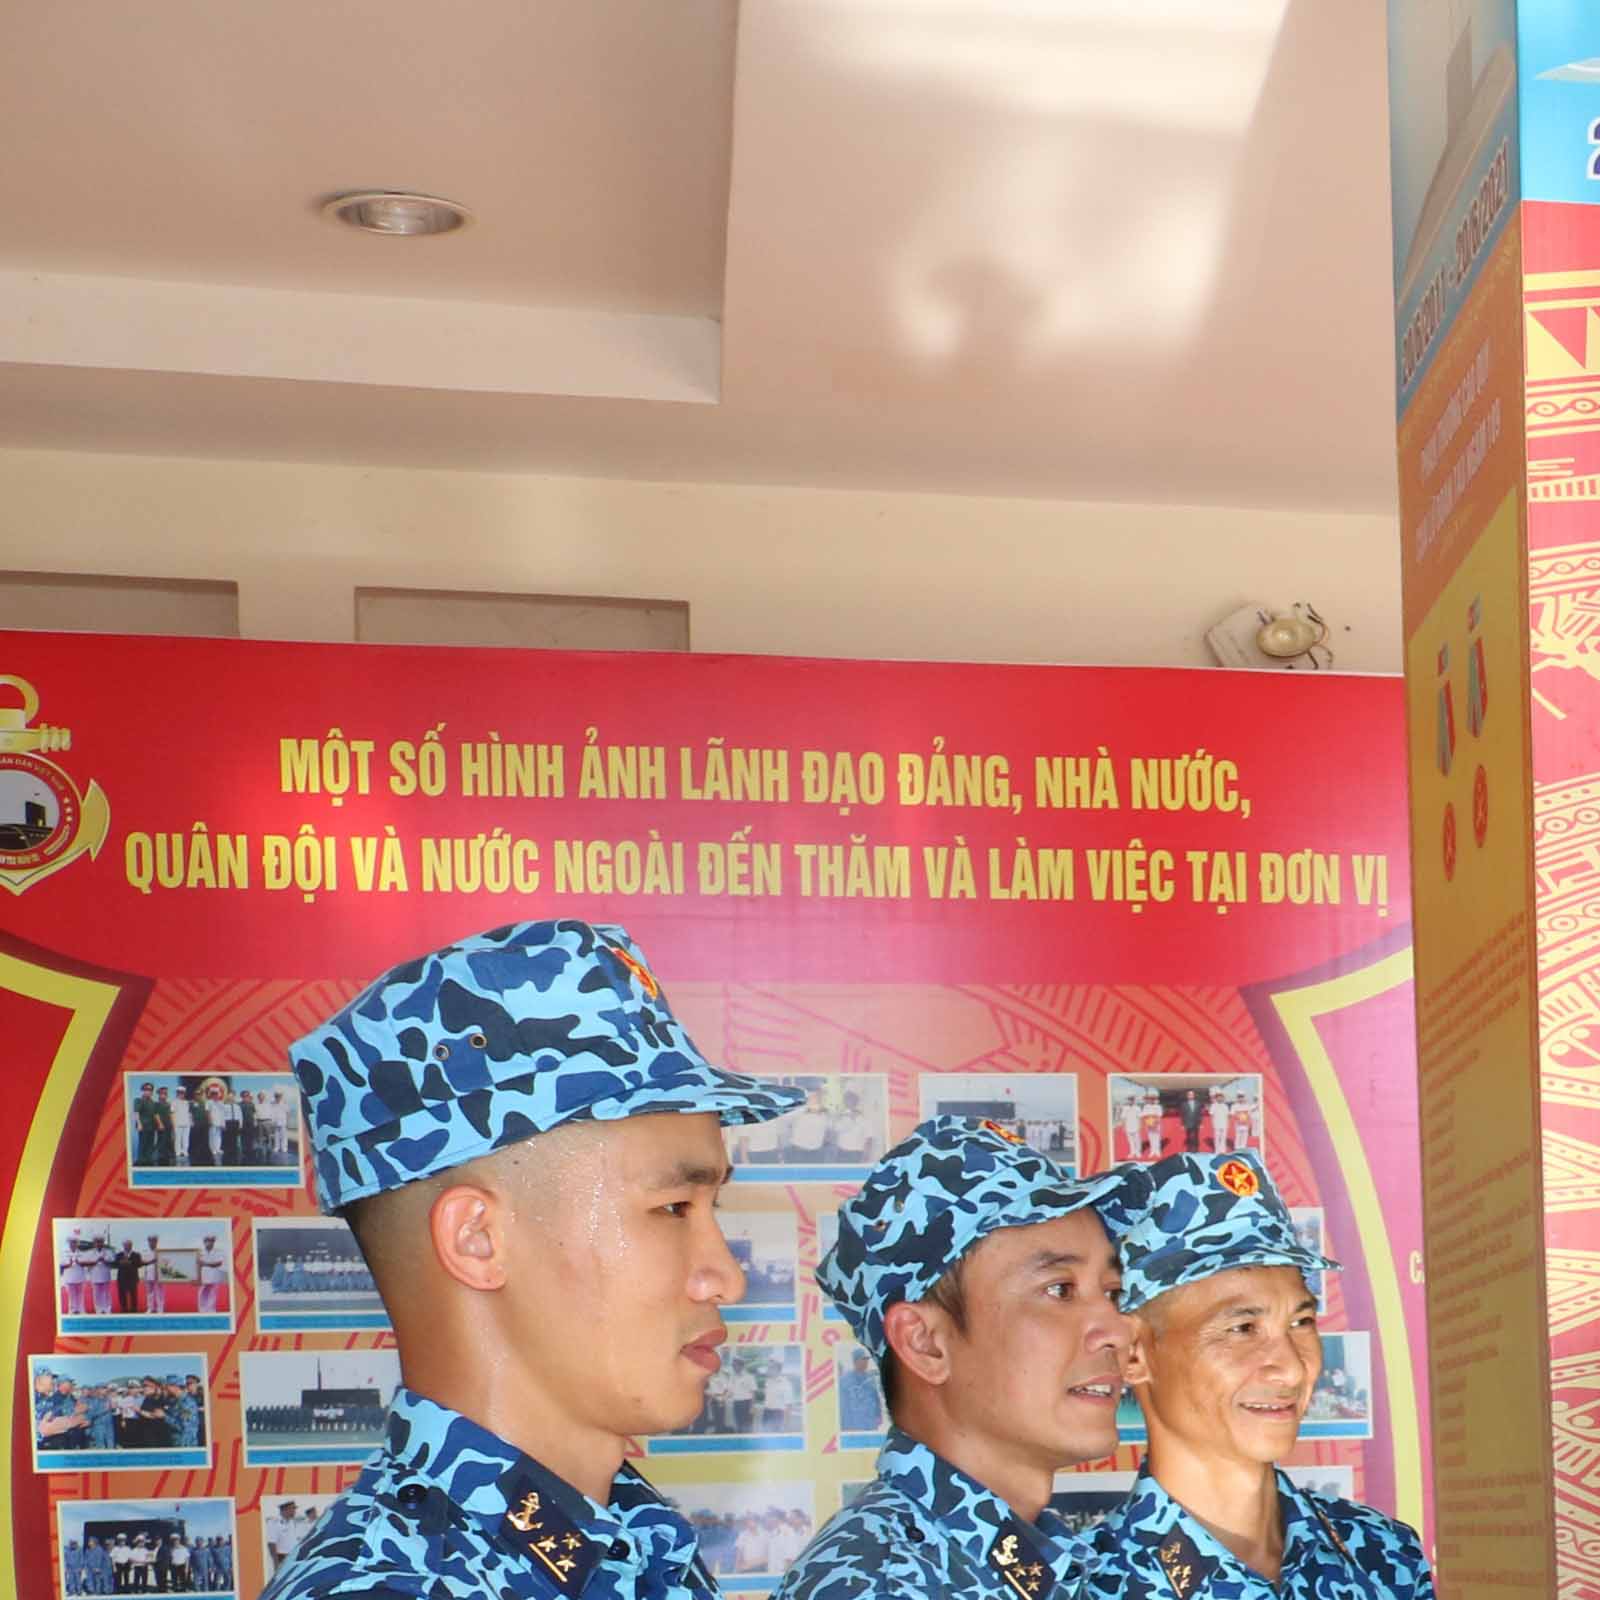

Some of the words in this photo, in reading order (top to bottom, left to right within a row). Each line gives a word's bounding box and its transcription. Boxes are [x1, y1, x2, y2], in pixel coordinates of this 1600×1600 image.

[279, 728, 375, 806] MỘT
[389, 722, 447, 796] SỐ
[461, 731, 564, 798] HÌNH
[579, 727, 666, 799] ẢNH
[680, 736, 789, 803] LÃNH
[801, 751, 885, 816] ĐẠO
[898, 736, 1023, 815] ĐẢNG,
[1035, 747, 1119, 808] NHÀ
[1131, 748, 1251, 818] NƯỚC,
[125, 821, 249, 894] QUÂN
[262, 823, 337, 903] ĐỘI
[350, 826, 408, 892] VÀ
[422, 827, 540, 893] NƯỚC
[554, 829, 684, 896] NGOÀI
[697, 825, 781, 897] ĐẾN
[794, 833, 910, 898] THĂM
[923, 835, 976, 899] VÀ
[989, 837, 1074, 901] LÀM
[1087, 838, 1174, 913] VIỆC
[1186, 850, 1247, 914] TẠI
[1259, 848, 1341, 904] ĐƠN
[1352, 854, 1388, 916] VỊ
